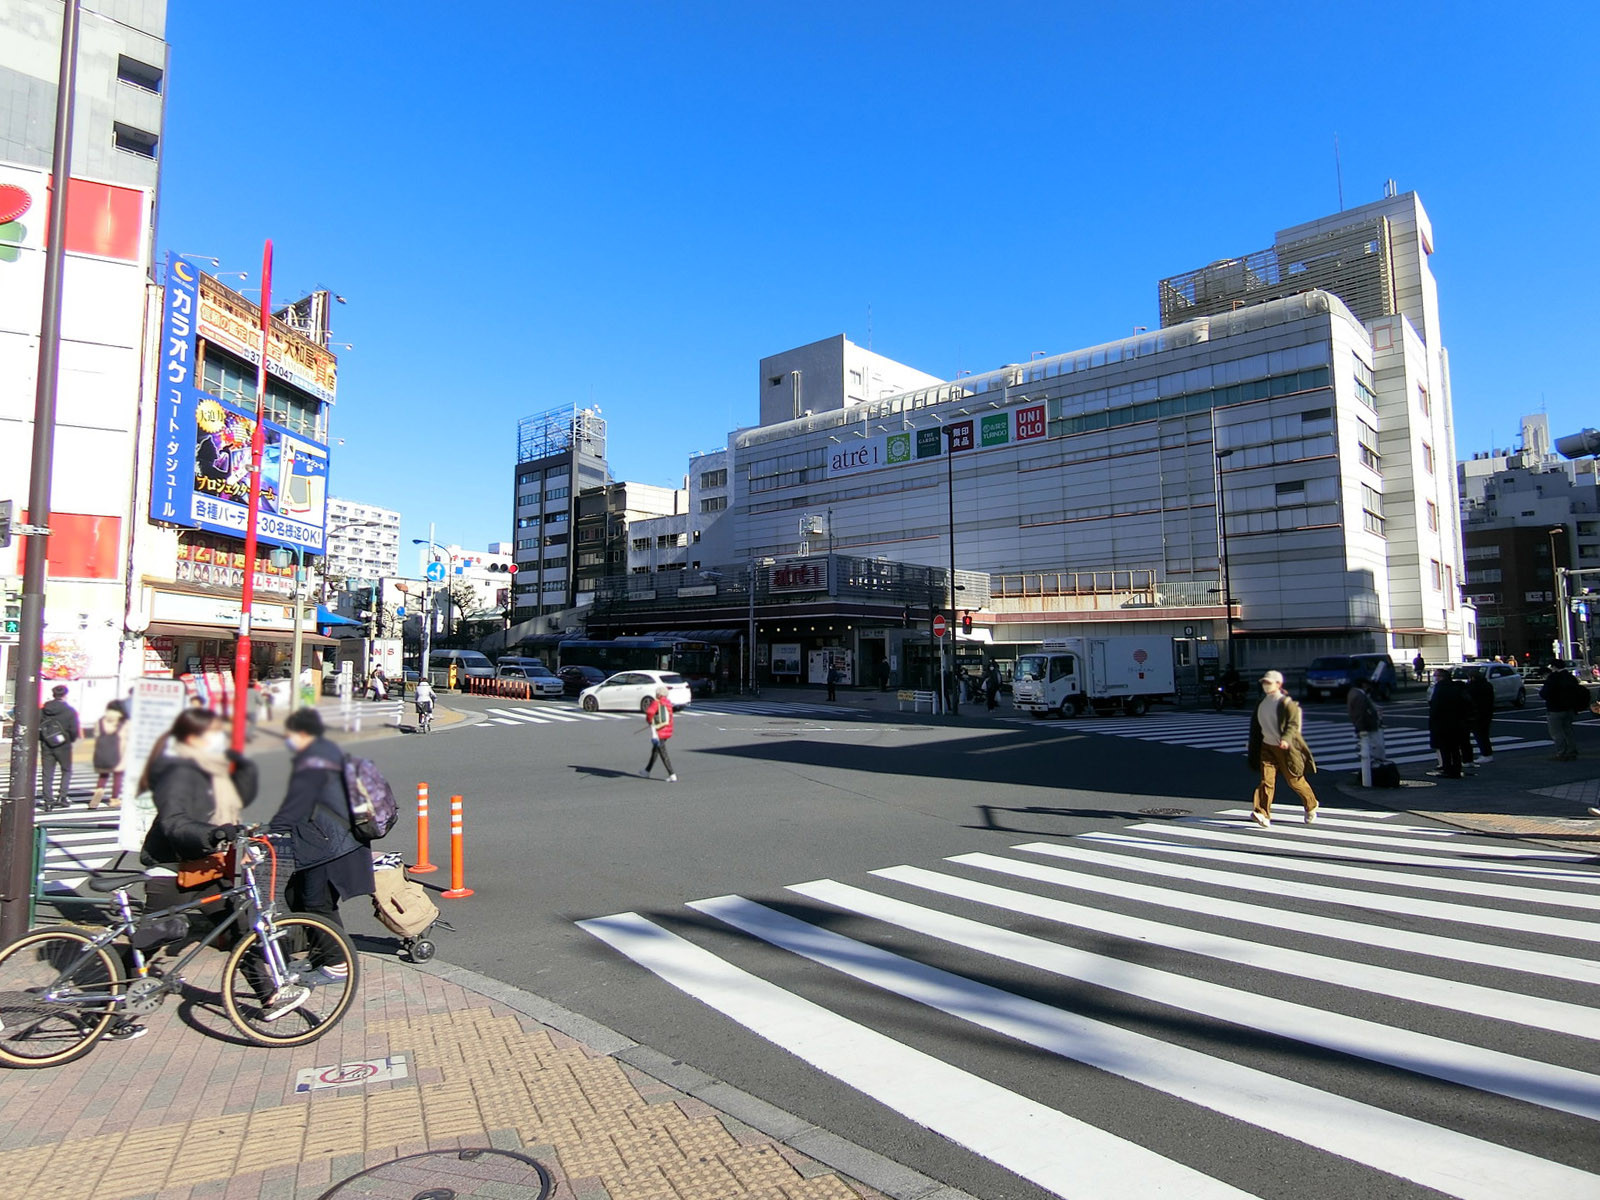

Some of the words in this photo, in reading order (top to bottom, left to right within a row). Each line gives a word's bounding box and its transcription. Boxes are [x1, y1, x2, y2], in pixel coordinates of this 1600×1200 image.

[168, 288, 192, 384] カラオケ
[251, 351, 294, 381] 372-7047
[201, 409, 225, 423] 大迫力
[1019, 409, 1040, 424] UNI
[1020, 423, 1042, 438] QLO
[163, 389, 182, 517] コート・ダジュール
[832, 445, 870, 471] atré
